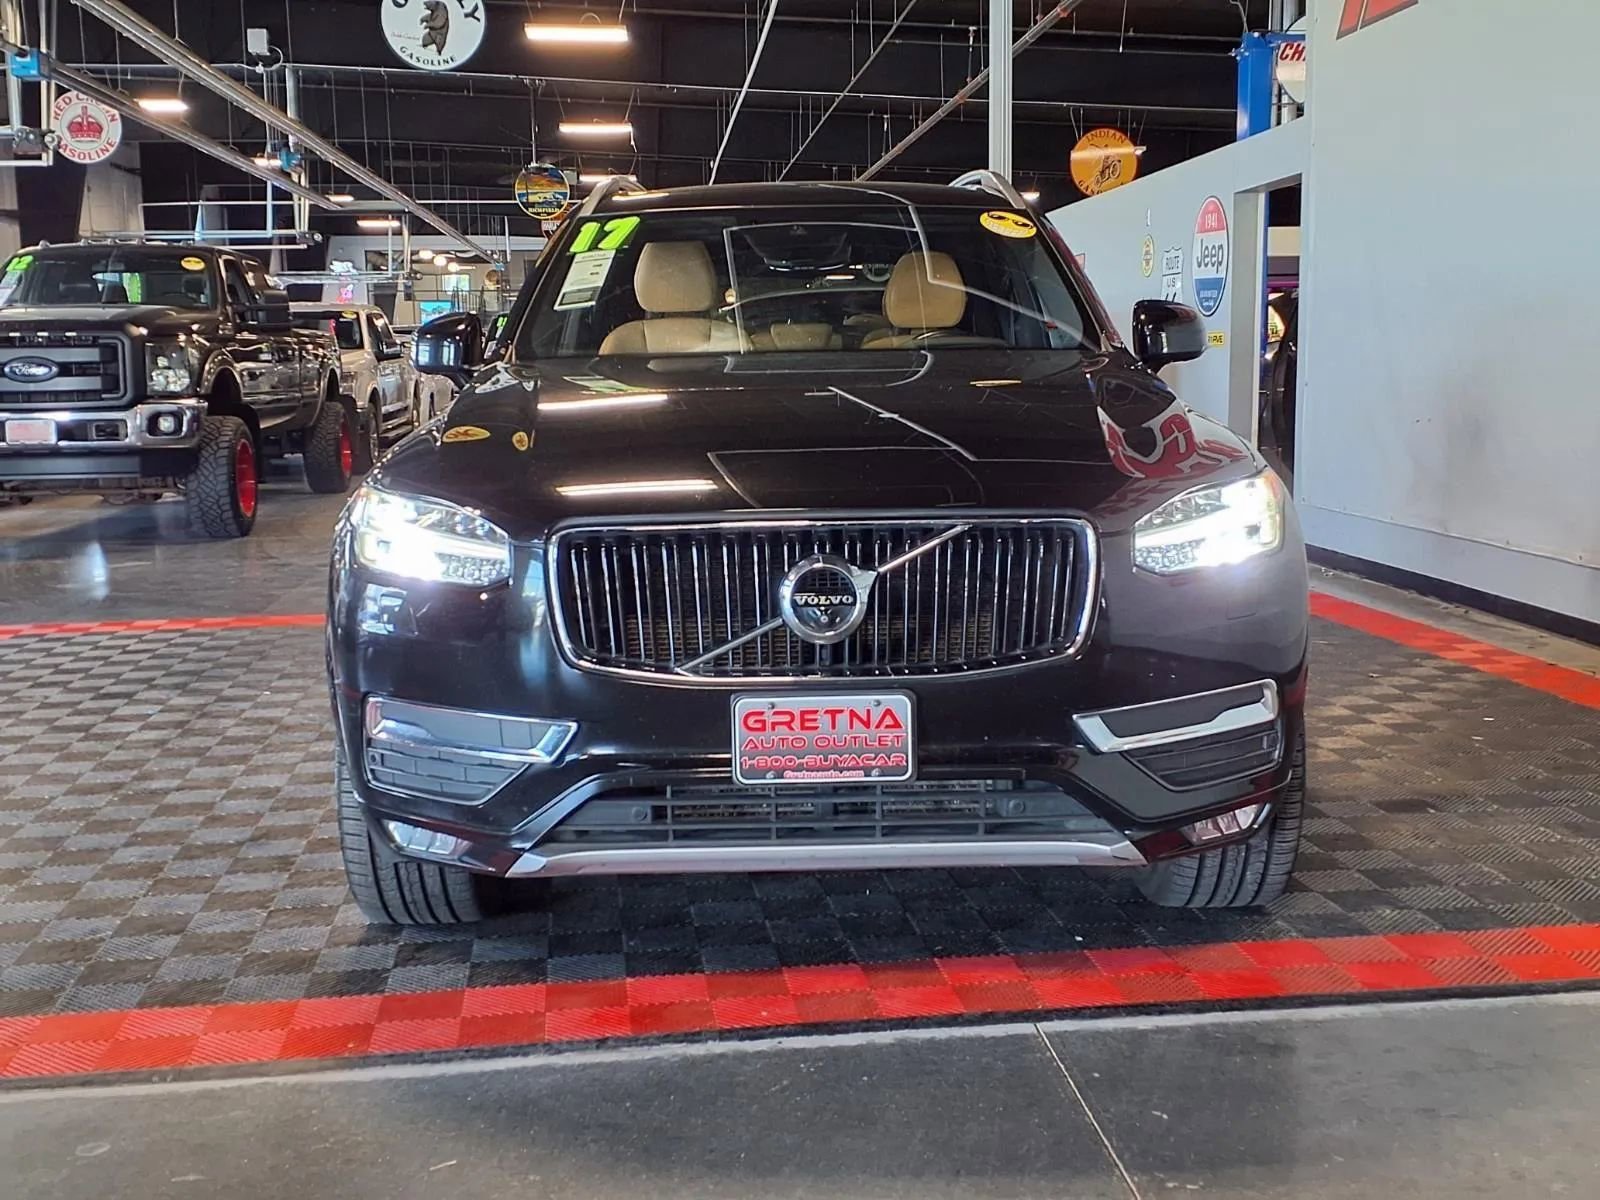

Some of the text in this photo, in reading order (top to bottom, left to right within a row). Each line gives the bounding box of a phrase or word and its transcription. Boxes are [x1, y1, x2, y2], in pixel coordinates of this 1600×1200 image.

[400, 46, 457, 66] GASOLINE
[1086, 130, 1126, 144] INDIAN
[1205, 213, 1218, 229] 1941
[569, 216, 641, 253] 17
[1165, 255, 1180, 270] ROUTE
[1196, 238, 1224, 273] Jeep
[1166, 277, 1176, 288] US
[793, 595, 854, 605] VOLVO
[742, 707, 904, 733] GRETNA
[742, 734, 905, 750] AUTO OUTLET
[741, 754, 906, 769] 1-800-BUYACAR
